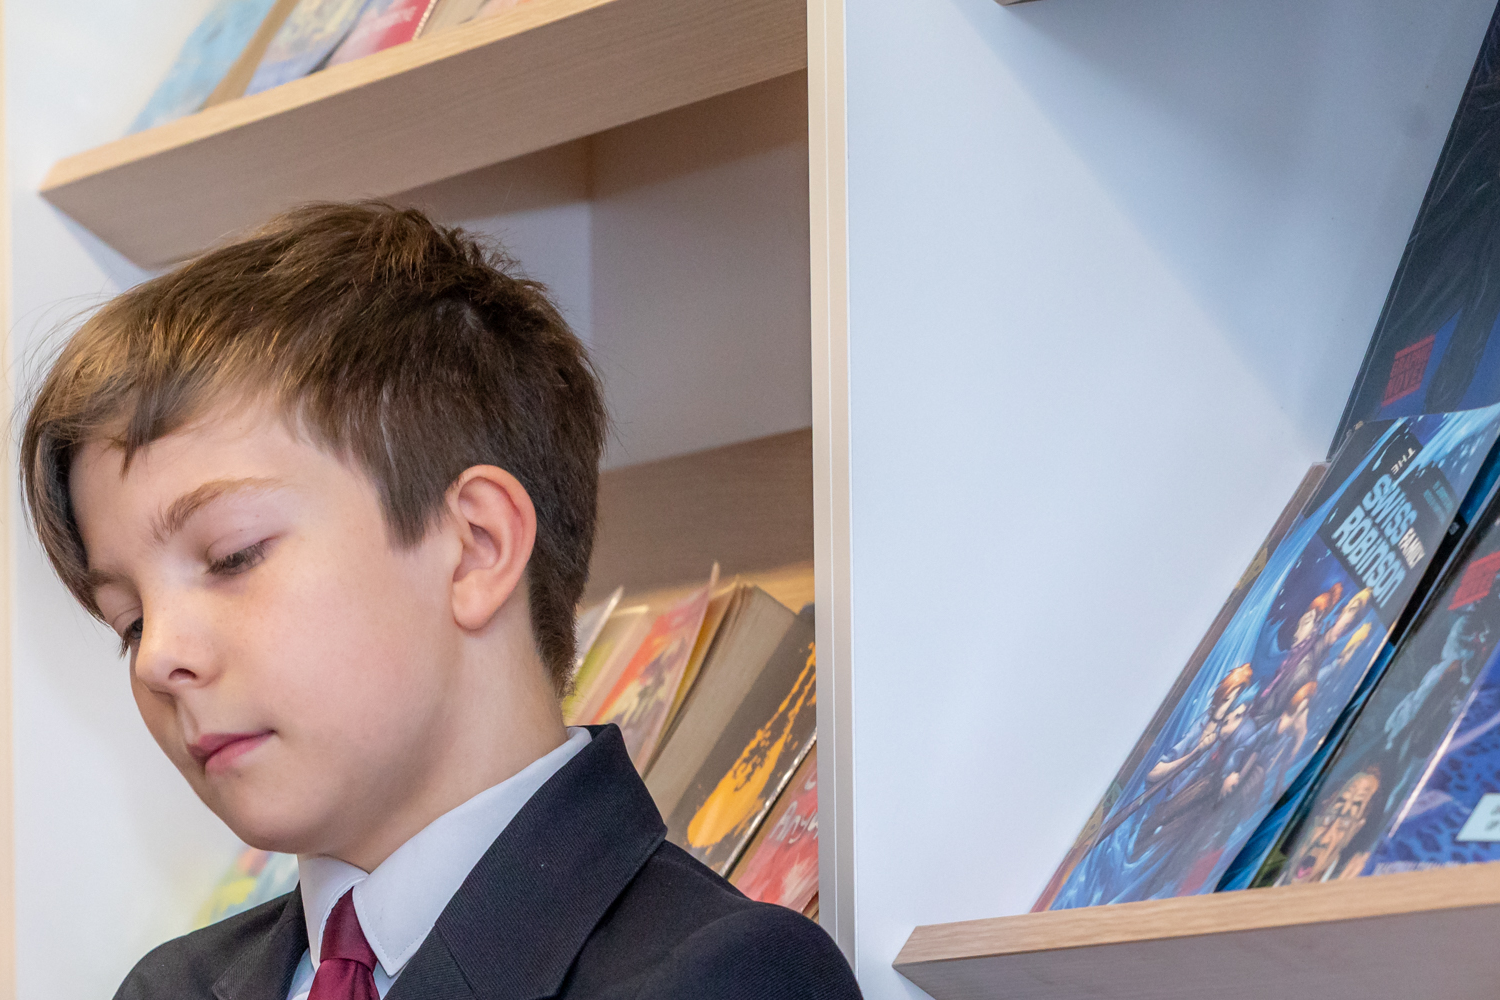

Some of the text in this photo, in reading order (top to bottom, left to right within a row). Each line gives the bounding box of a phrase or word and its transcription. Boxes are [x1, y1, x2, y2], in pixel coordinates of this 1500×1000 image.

[1390, 447, 1416, 475] THE
[1398, 527, 1426, 570] FAMILY
[769, 801, 818, 844] Any
